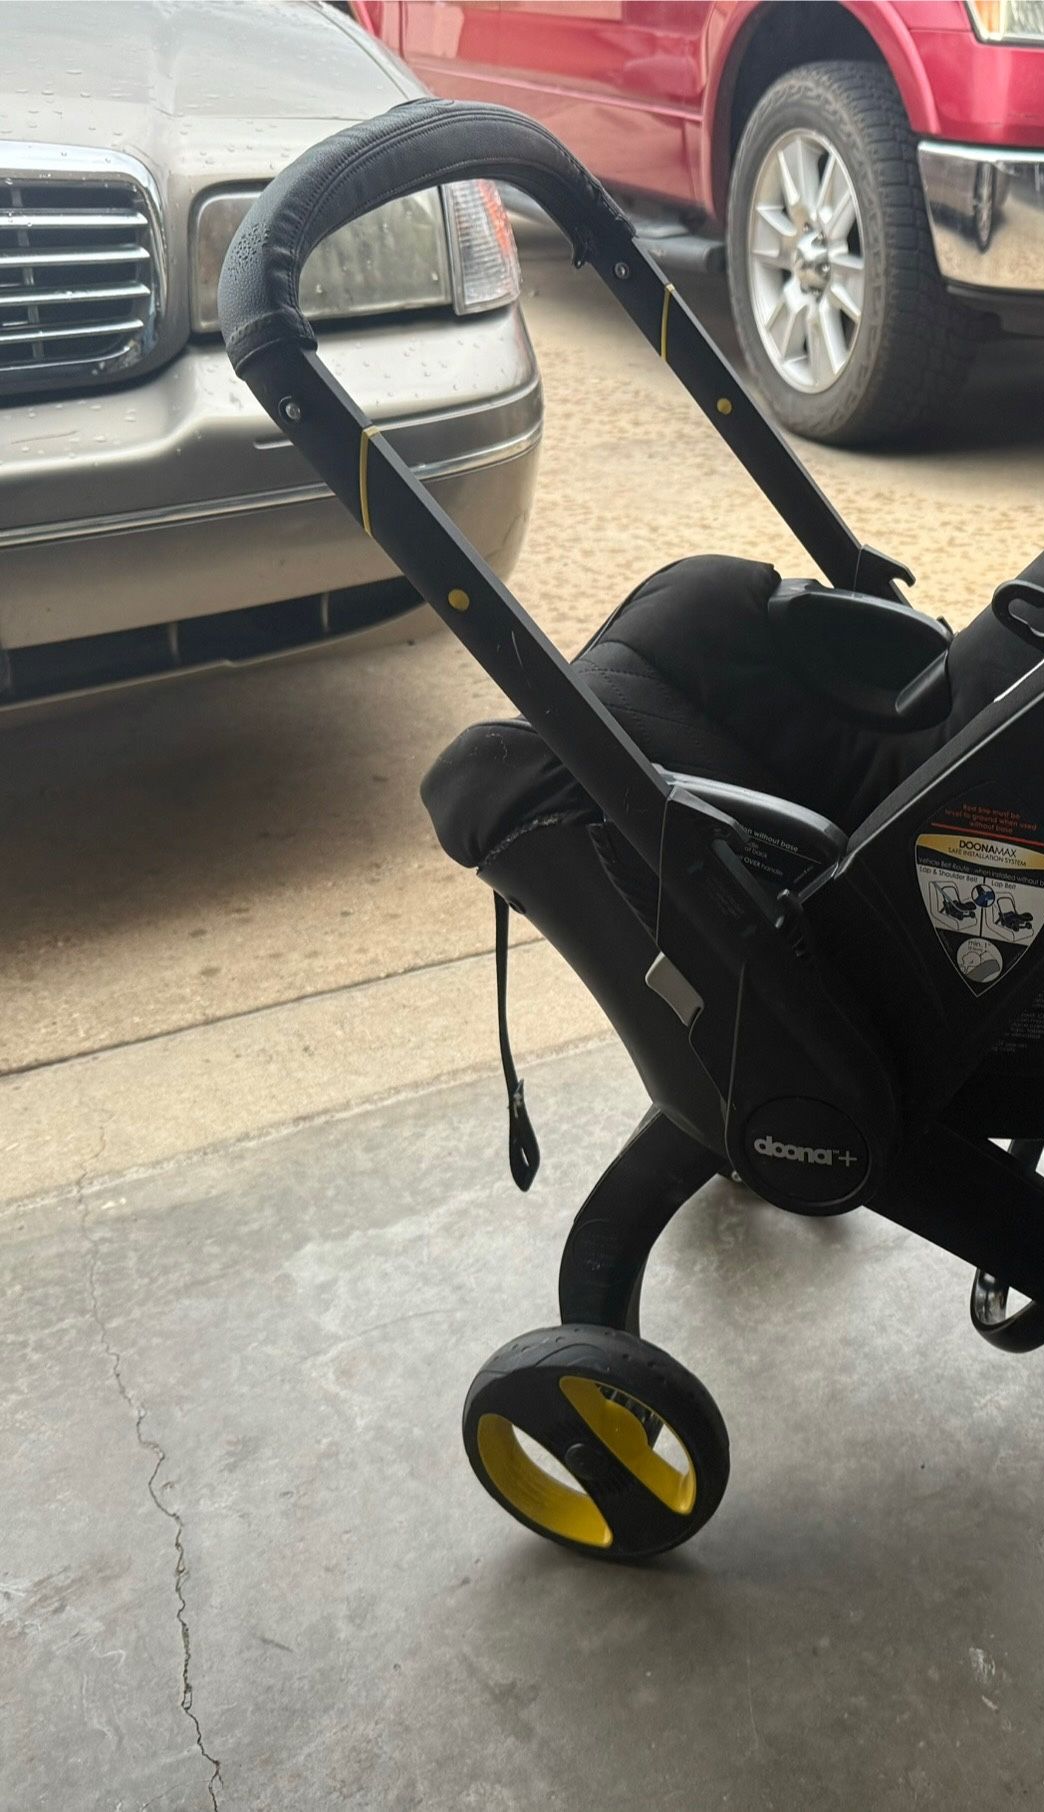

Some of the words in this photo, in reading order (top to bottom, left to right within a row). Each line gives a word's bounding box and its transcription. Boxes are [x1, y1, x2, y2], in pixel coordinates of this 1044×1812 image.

[753, 831, 780, 845] without
[780, 839, 799, 852] base
[959, 839, 1017, 858] DOONAMAX
